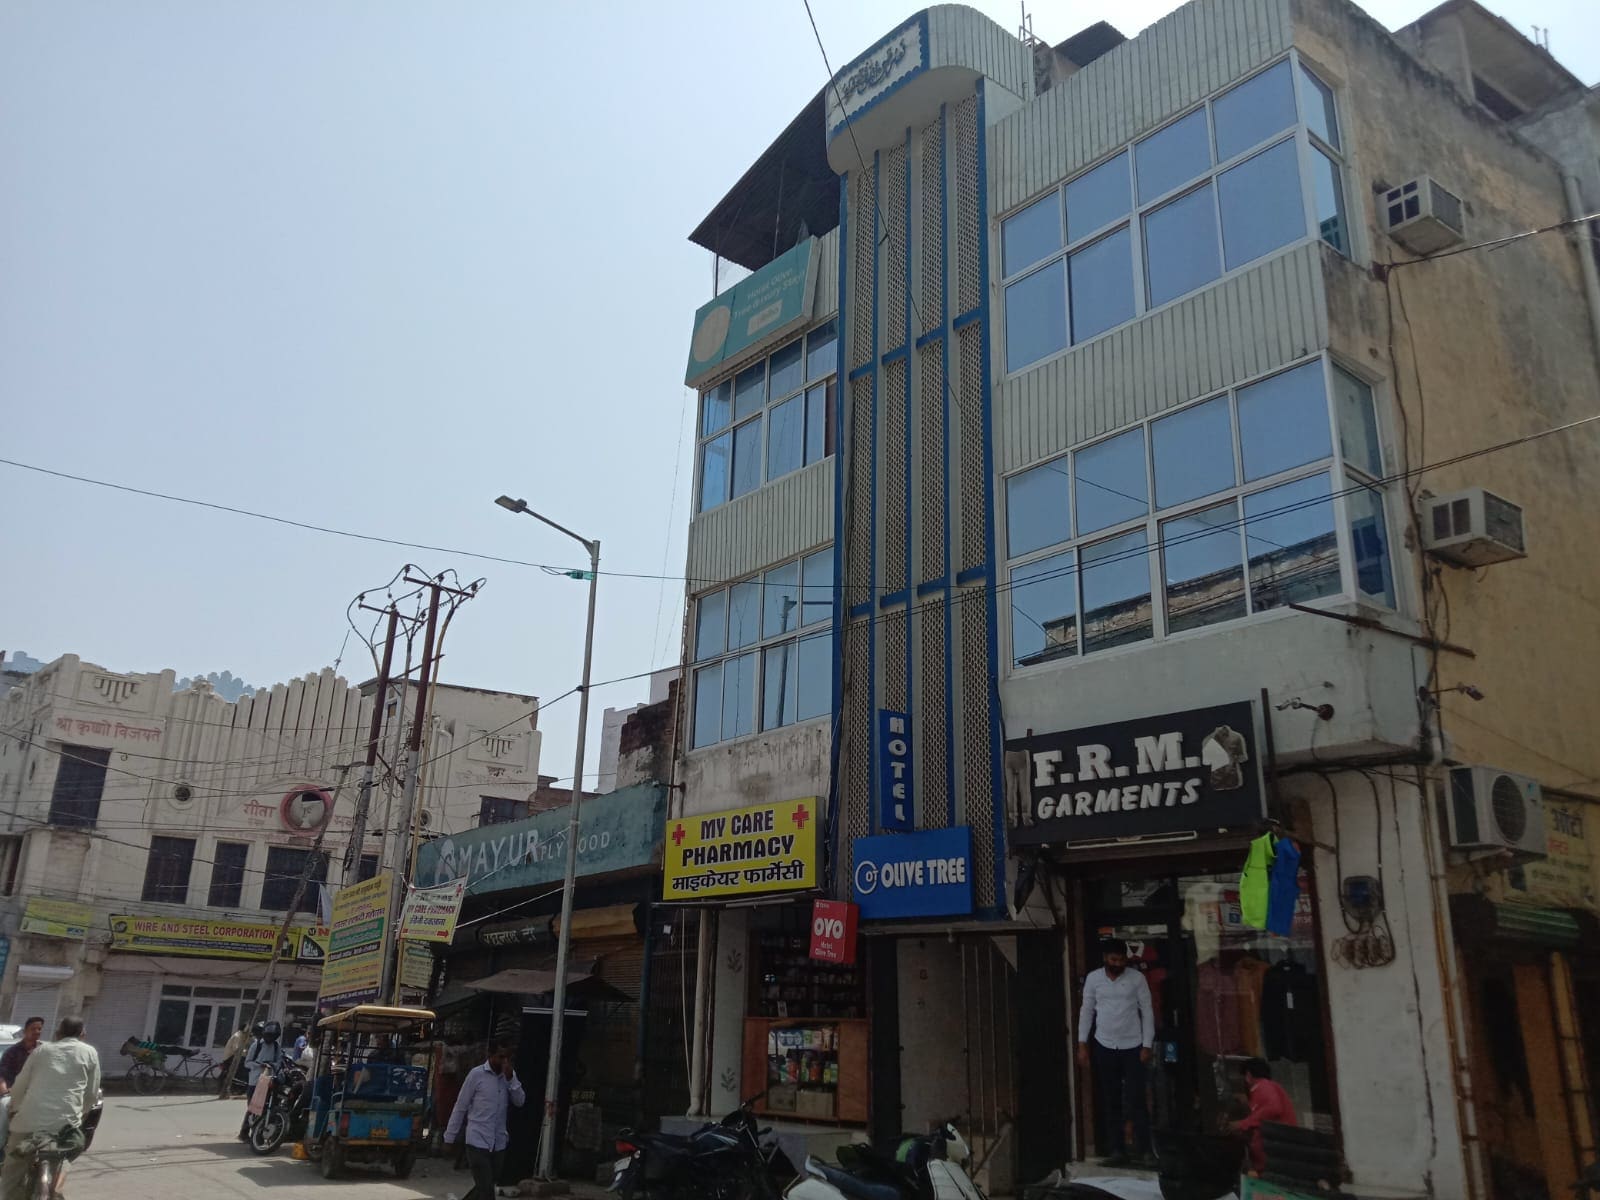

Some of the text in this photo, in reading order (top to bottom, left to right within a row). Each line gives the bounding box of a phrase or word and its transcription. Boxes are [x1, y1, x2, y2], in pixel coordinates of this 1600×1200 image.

[887, 716, 907, 822] HOTEL
[1033, 731, 1201, 788] F.R.M.
[1037, 778, 1202, 820] GARMENTS
[700, 809, 774, 841] MY CARE
[458, 828, 611, 876] MAYUR PLYOOD
[682, 834, 795, 867] PHARMACY
[672, 859, 805, 892] माइकेयर फार्मेसी
[881, 859, 924, 889] OLIVE
[926, 856, 966, 886] TREE
[134, 920, 158, 932] WIRE
[161, 922, 179, 933] AND
[182, 923, 210, 936] STEEL
[213, 926, 276, 940] CORPORATION
[813, 917, 844, 940] OYO
